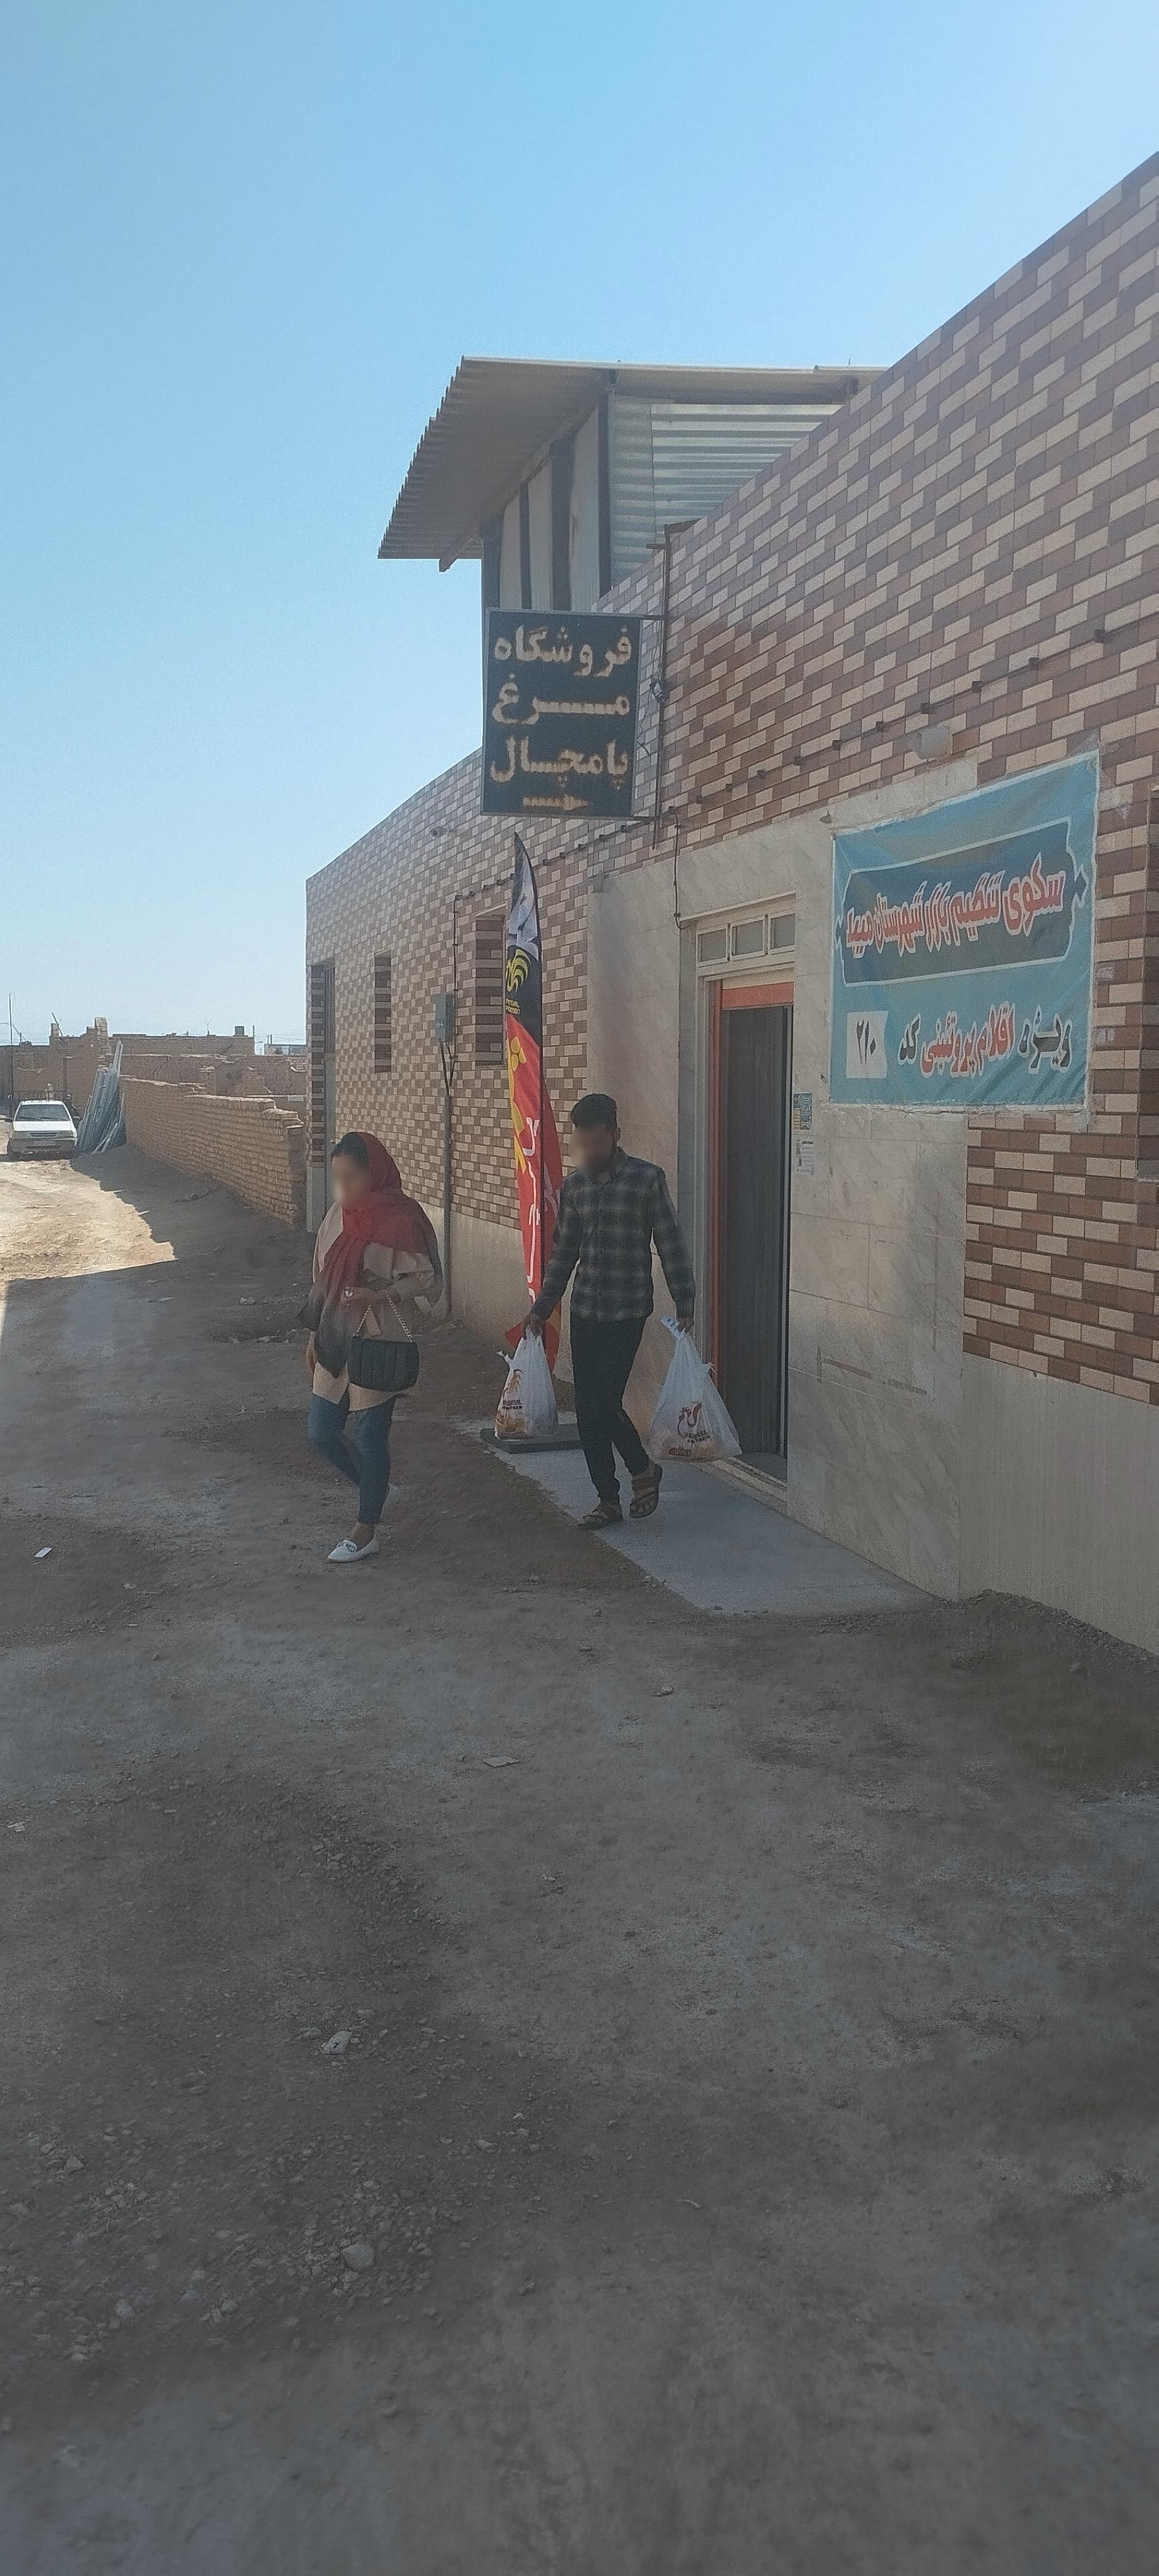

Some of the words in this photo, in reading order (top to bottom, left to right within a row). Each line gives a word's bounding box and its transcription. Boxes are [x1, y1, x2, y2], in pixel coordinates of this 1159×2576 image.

[494, 626, 631, 677] فروشگاه
[492, 674, 630, 725] مرغ
[490, 735, 628, 790] پامچال
[874, 881, 925, 957] شهرستان
[925, 881, 951, 953] بازار
[949, 870, 1005, 946] تنظیم
[1002, 852, 1066, 937] سکوی
[856, 1020, 876, 1065] ۲۱۰
[898, 1013, 921, 1064] کد
[920, 1010, 977, 1078] پروتئینی
[977, 1001, 1015, 1076] اقلام
[1018, 1005, 1072, 1076] ویژه
